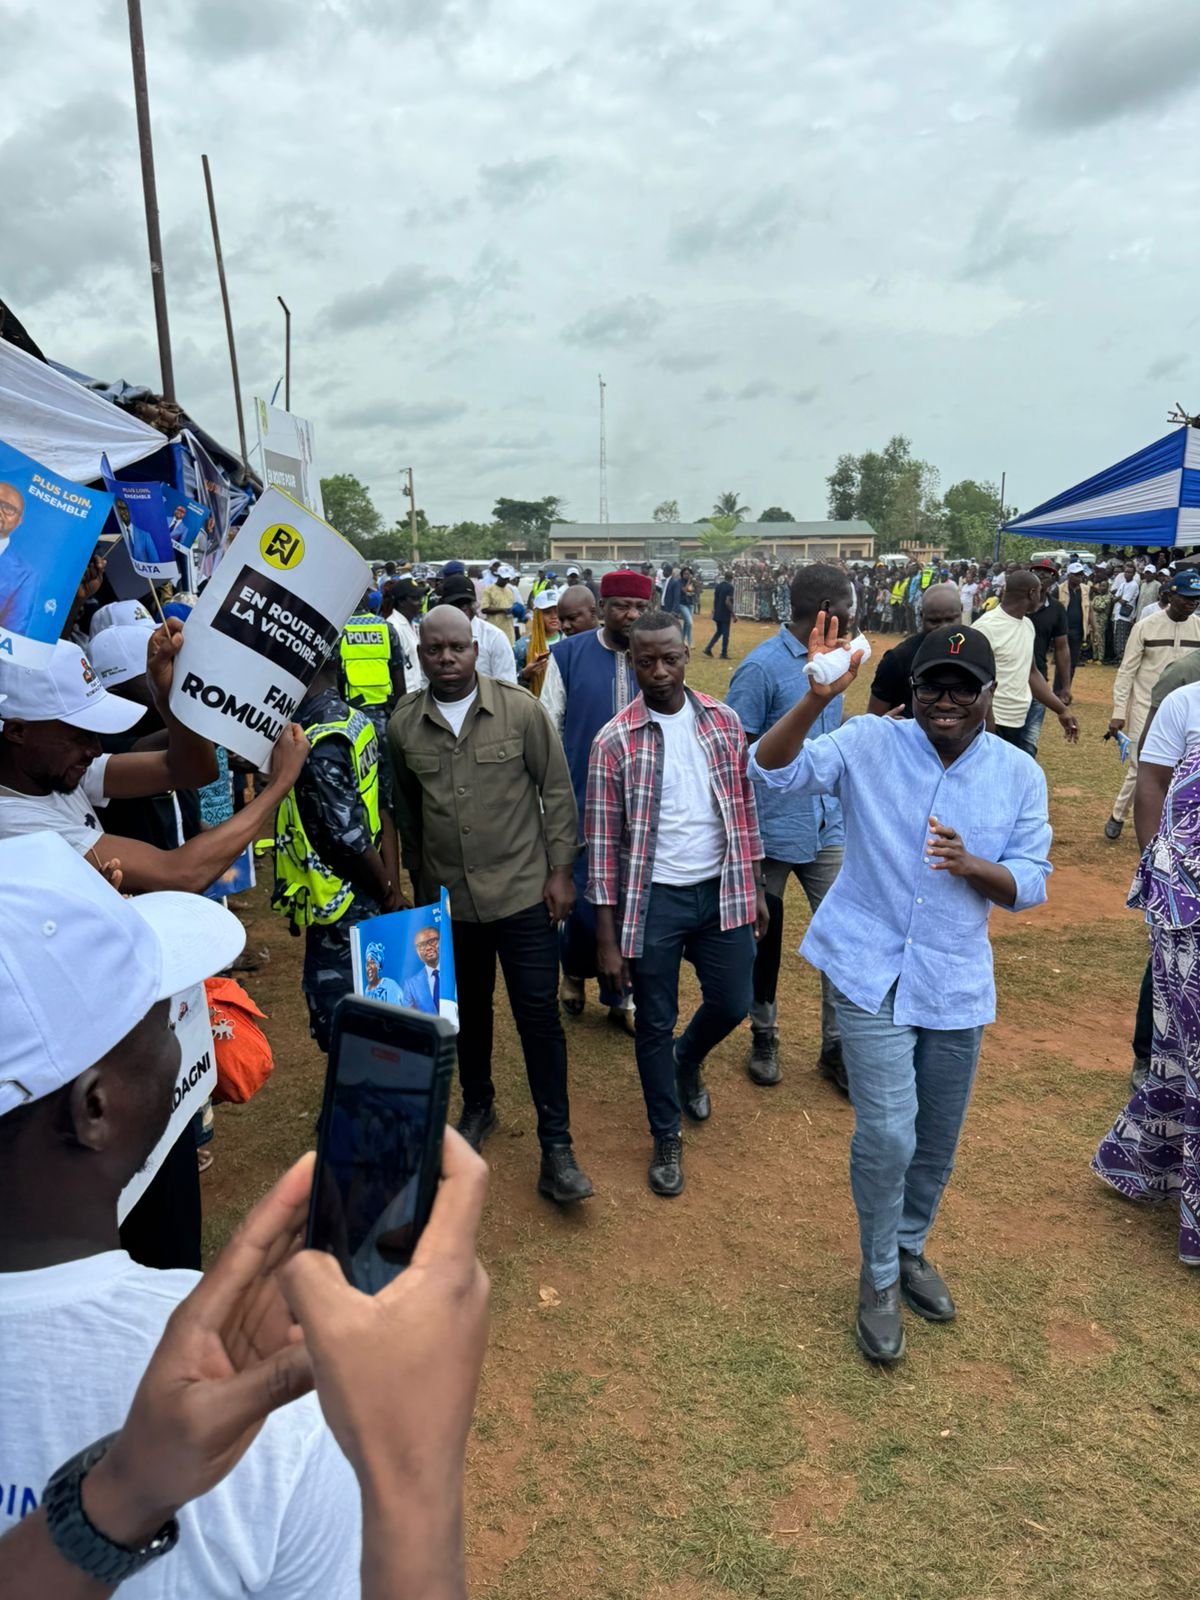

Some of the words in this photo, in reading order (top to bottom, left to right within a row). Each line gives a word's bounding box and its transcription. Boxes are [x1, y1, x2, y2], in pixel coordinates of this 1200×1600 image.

[28, 485, 89, 518] ENSEMBLE
[32, 474, 61, 496] PLUS
[62, 491, 93, 509] LOIN,
[230, 602, 255, 625] LA
[239, 586, 268, 609] EN
[268, 602, 316, 642] ROUTE
[347, 632, 384, 644] POLICE
[171, 1051, 211, 1114] DAGNI
